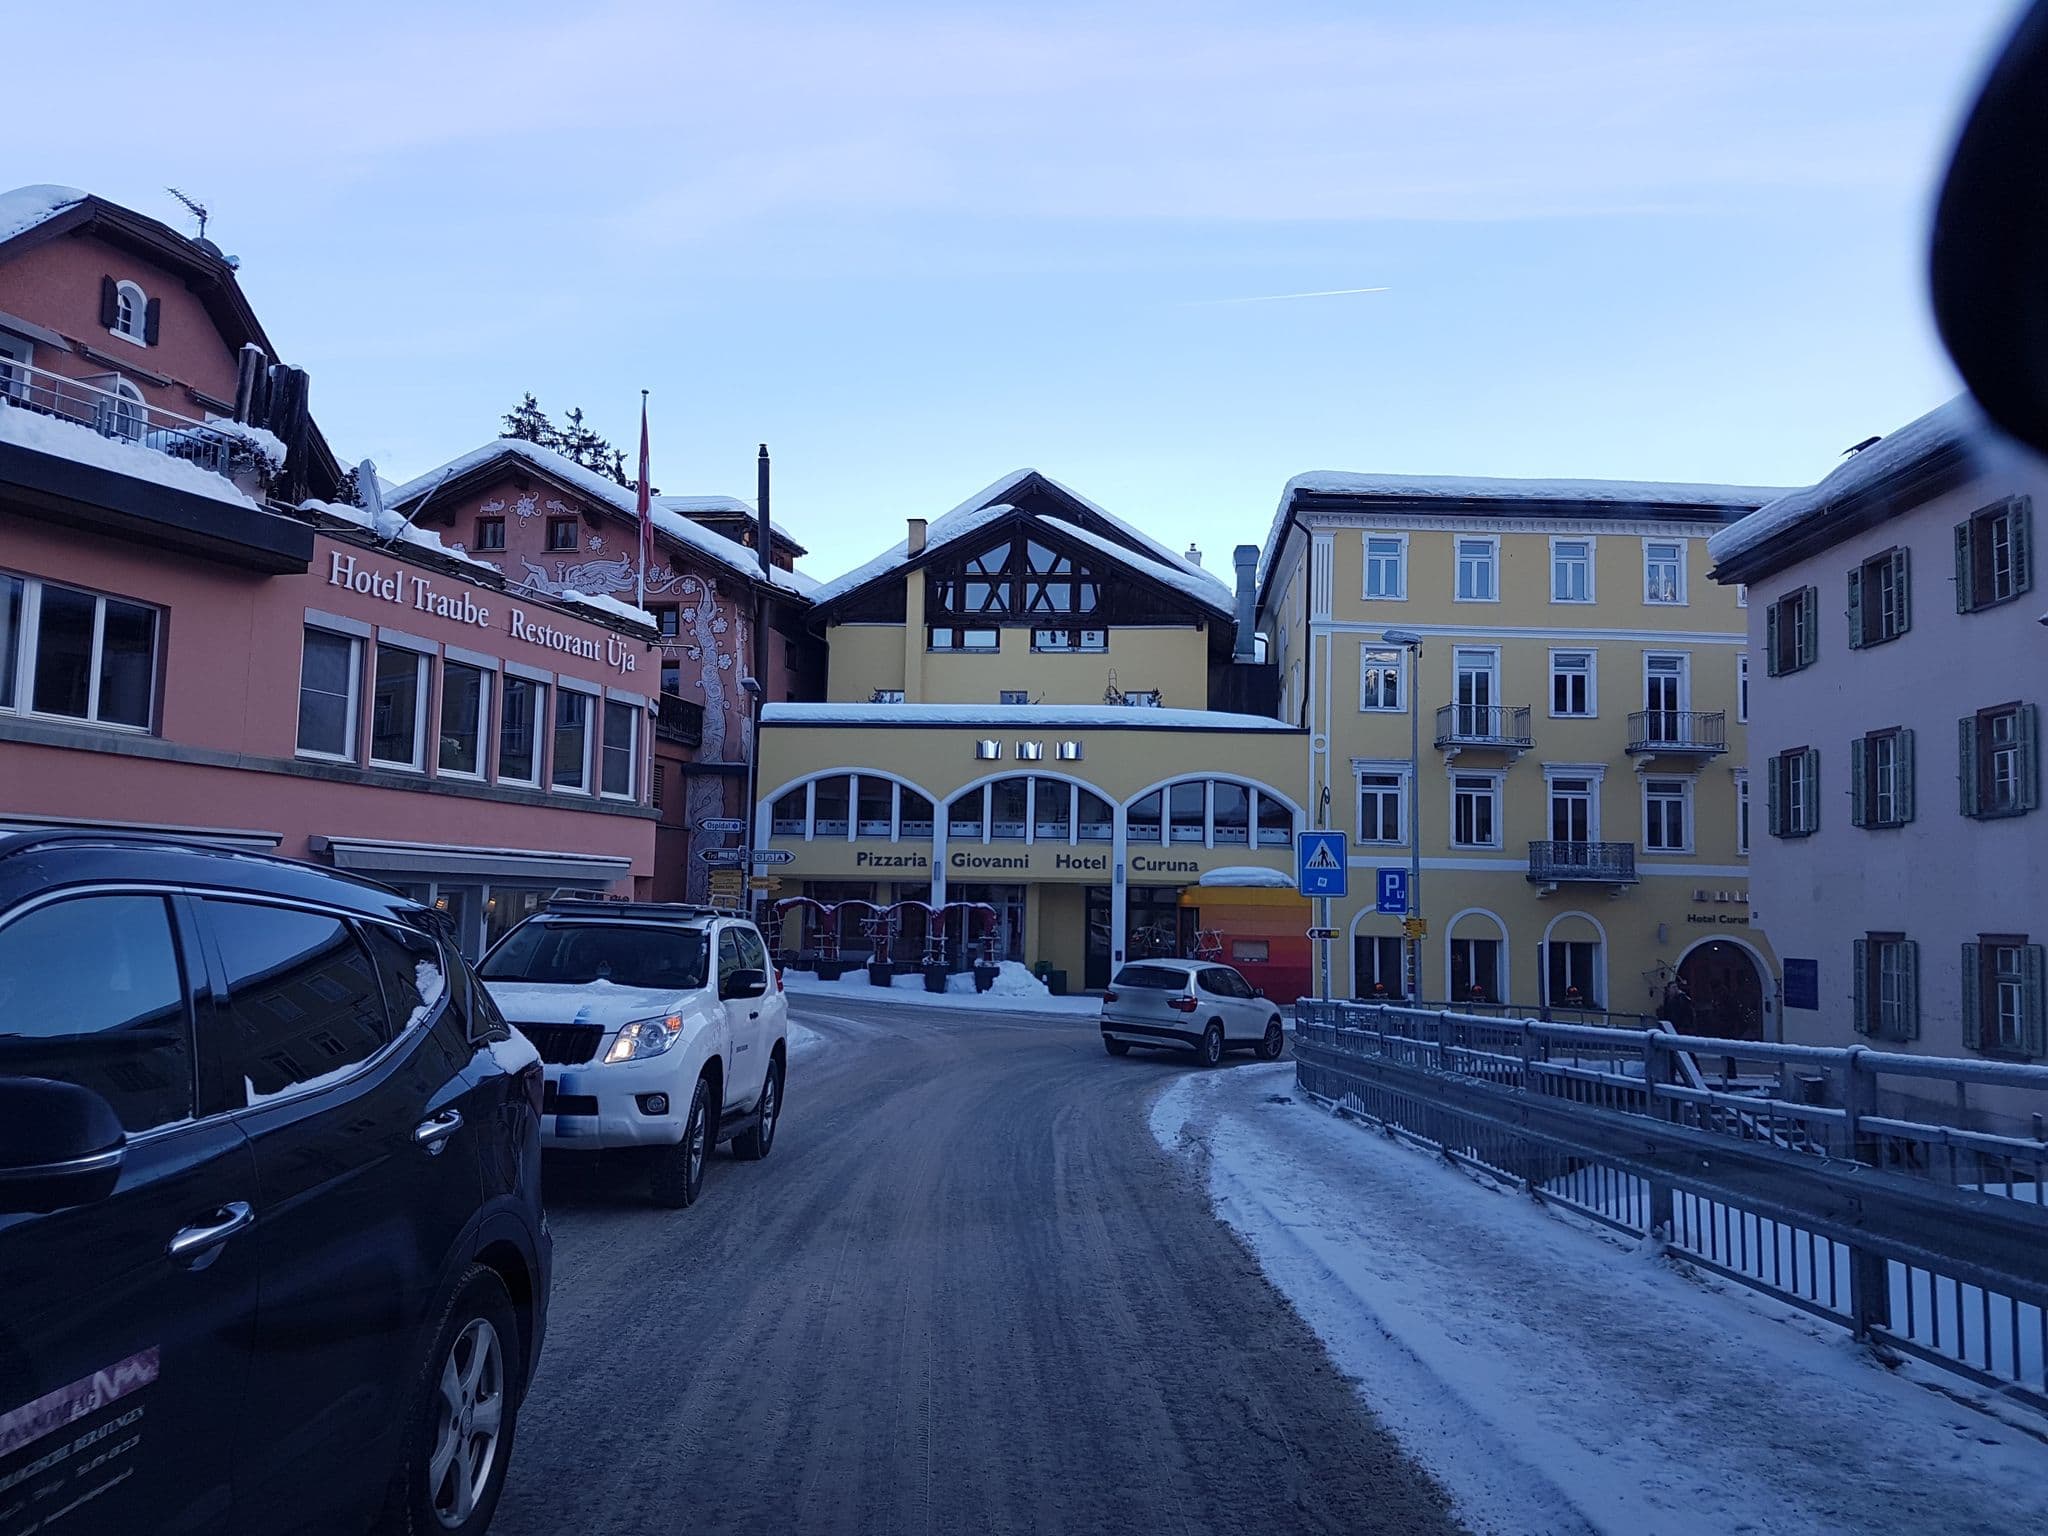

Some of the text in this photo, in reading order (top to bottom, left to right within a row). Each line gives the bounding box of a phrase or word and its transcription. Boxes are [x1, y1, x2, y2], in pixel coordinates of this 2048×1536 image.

[330, 551, 490, 628] Hotel Traube
[510, 608, 636, 674] Restorant Üja
[856, 852, 1029, 868] Pizzaria Giovanni
[1056, 854, 1199, 873] Hotel Curuna
[1385, 875, 1399, 897] P
[1687, 914, 1749, 925] Hotel Curun
